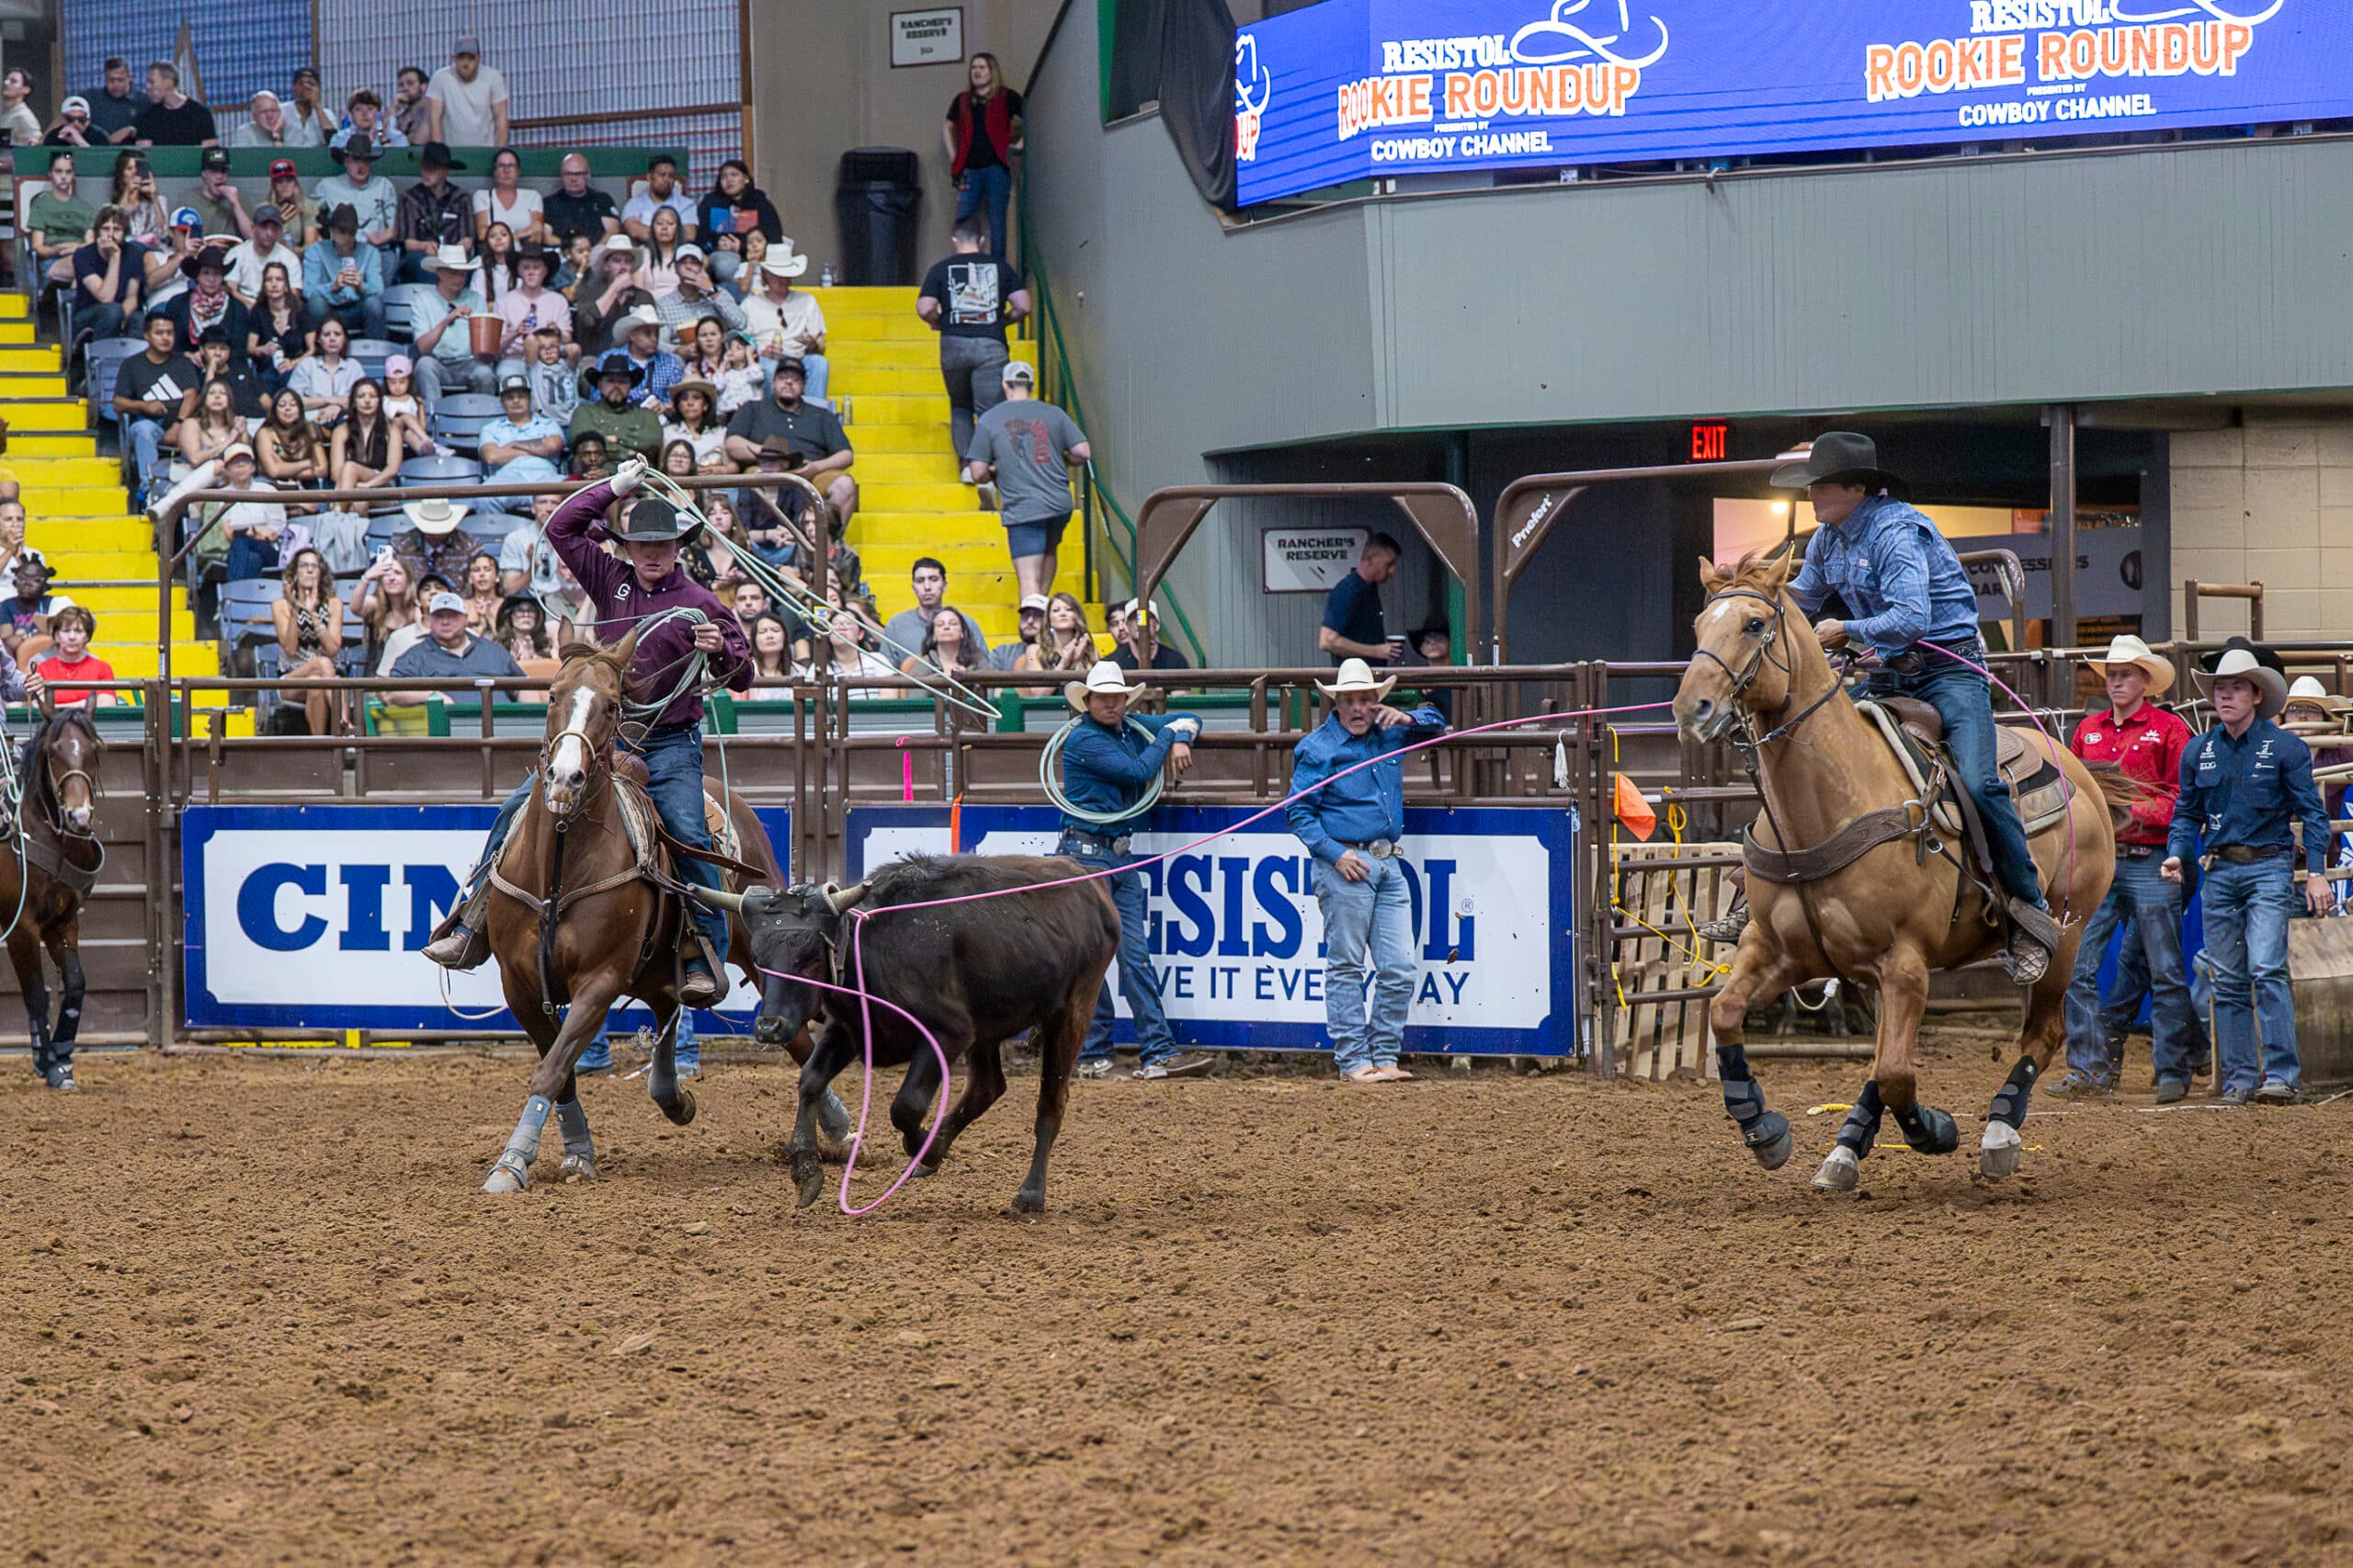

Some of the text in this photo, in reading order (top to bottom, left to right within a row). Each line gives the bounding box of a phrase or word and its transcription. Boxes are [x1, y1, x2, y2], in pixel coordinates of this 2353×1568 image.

[1970, 0, 2113, 33] RESISTOL
[1381, 35, 1512, 73] RESISTOL
[1866, 23, 2253, 102] ROOKIE ROUNDUP
[1338, 64, 1641, 142] ROOKIE ROUNDUP
[1959, 94, 2157, 127] COWBOY CHANNEL
[1370, 131, 1553, 162] COWBOY CHANNEL
[1692, 426, 1727, 459] EXIT
[1278, 538, 1356, 548] RANCHER'S
[1286, 550, 1347, 561] RESERVE
[236, 862, 469, 951] CIN
[1211, 967, 1241, 1000] IT
[1256, 968, 1377, 1003] EVEY
[1410, 971, 1470, 1005] AY
